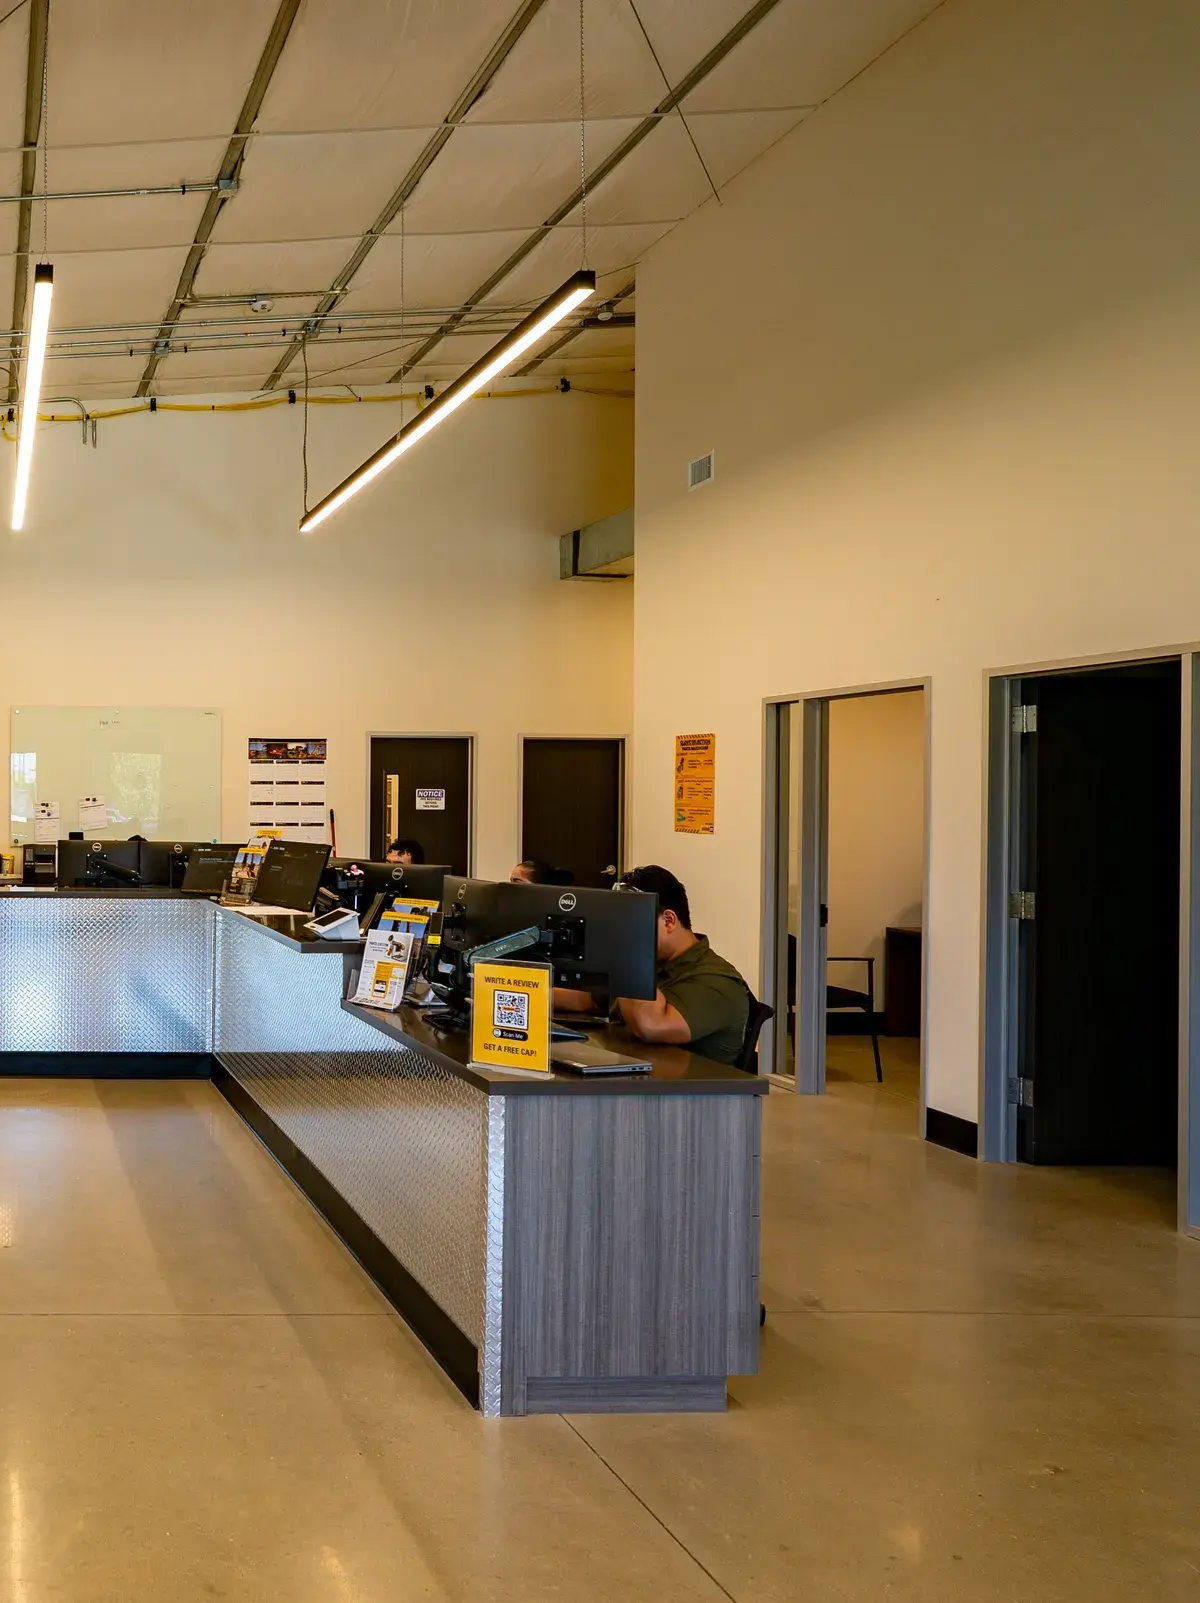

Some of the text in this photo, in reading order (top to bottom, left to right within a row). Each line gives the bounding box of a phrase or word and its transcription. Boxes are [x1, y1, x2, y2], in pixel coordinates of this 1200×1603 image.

[484, 976, 505, 986] WRITE
[513, 979, 540, 989] REVIEW
[483, 1043, 537, 1057] GET A FREE CAP!
